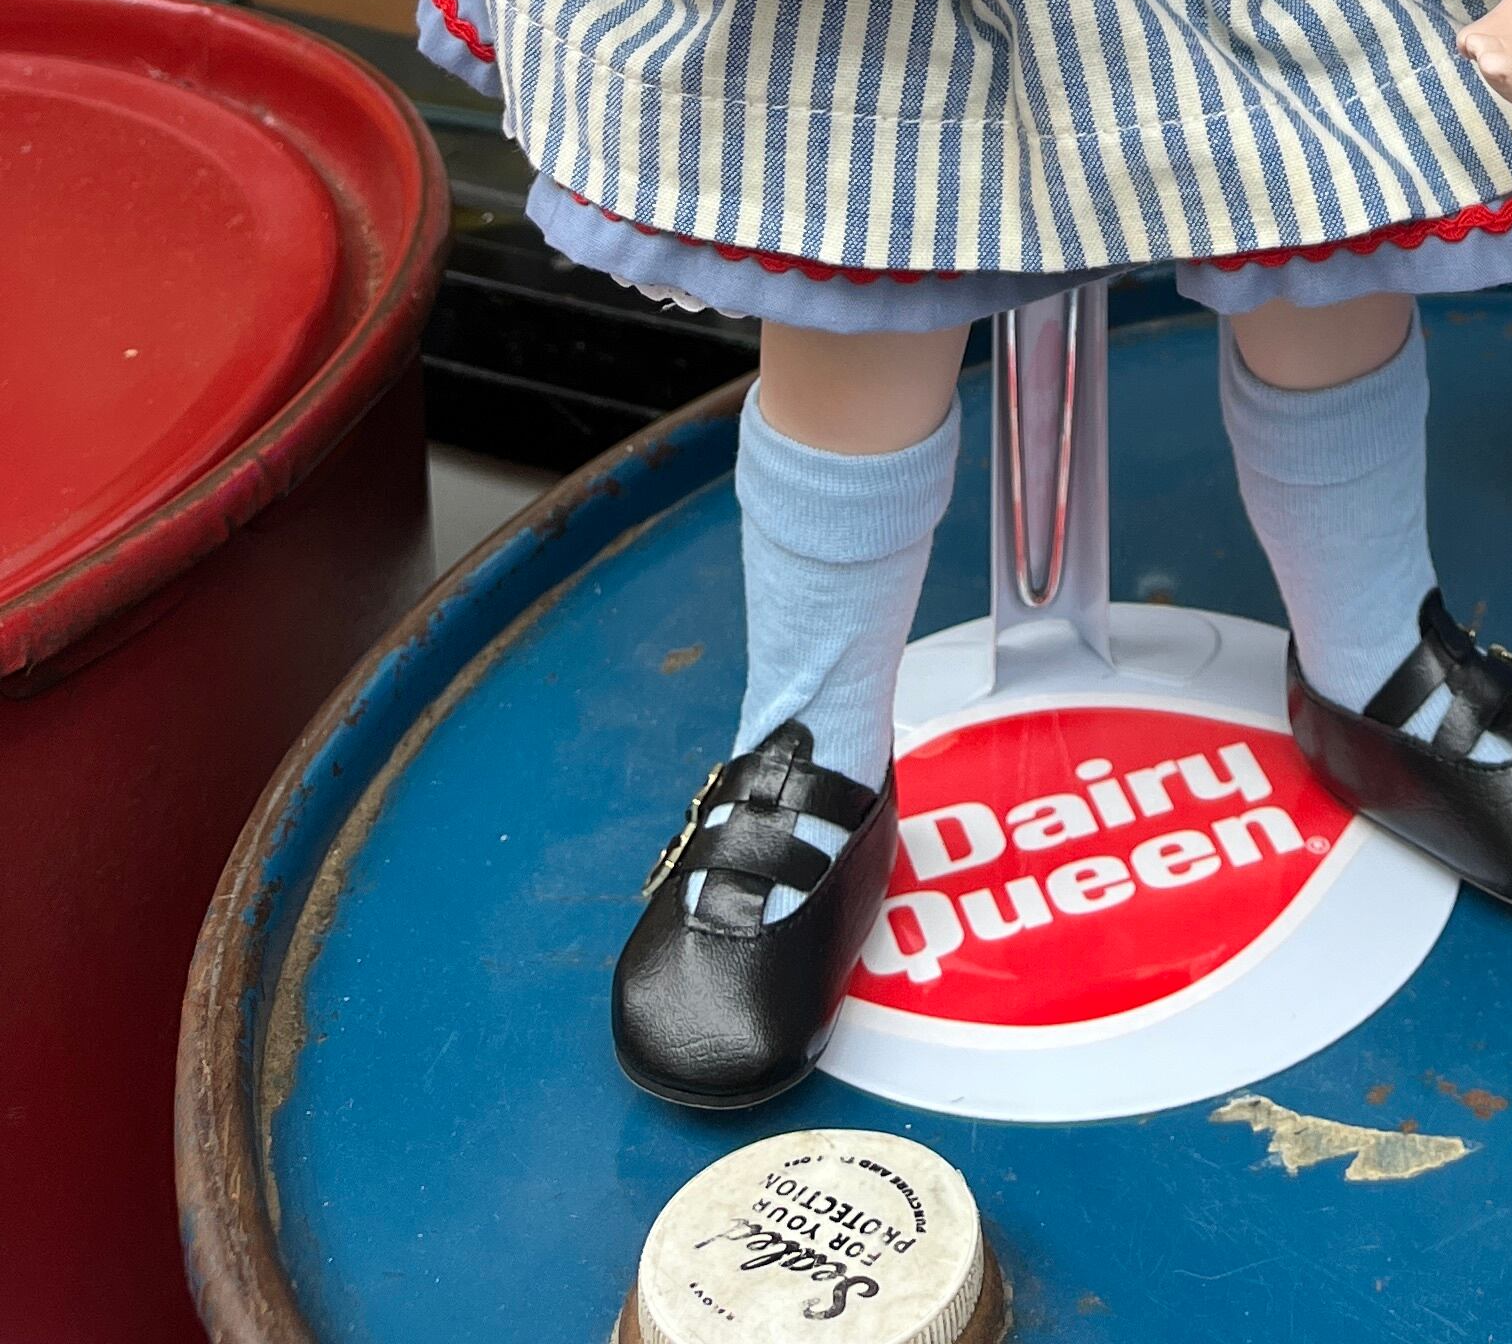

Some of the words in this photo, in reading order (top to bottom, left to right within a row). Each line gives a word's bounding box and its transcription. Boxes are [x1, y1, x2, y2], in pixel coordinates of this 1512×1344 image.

[897, 741, 1274, 882] Dairy
[859, 805, 1305, 984] Queen
[751, 1197, 822, 1241] YOUR
[762, 1172, 918, 1255] PROTECTION
[829, 1232, 882, 1267] FOR
[694, 1217, 881, 1321] Sealed
